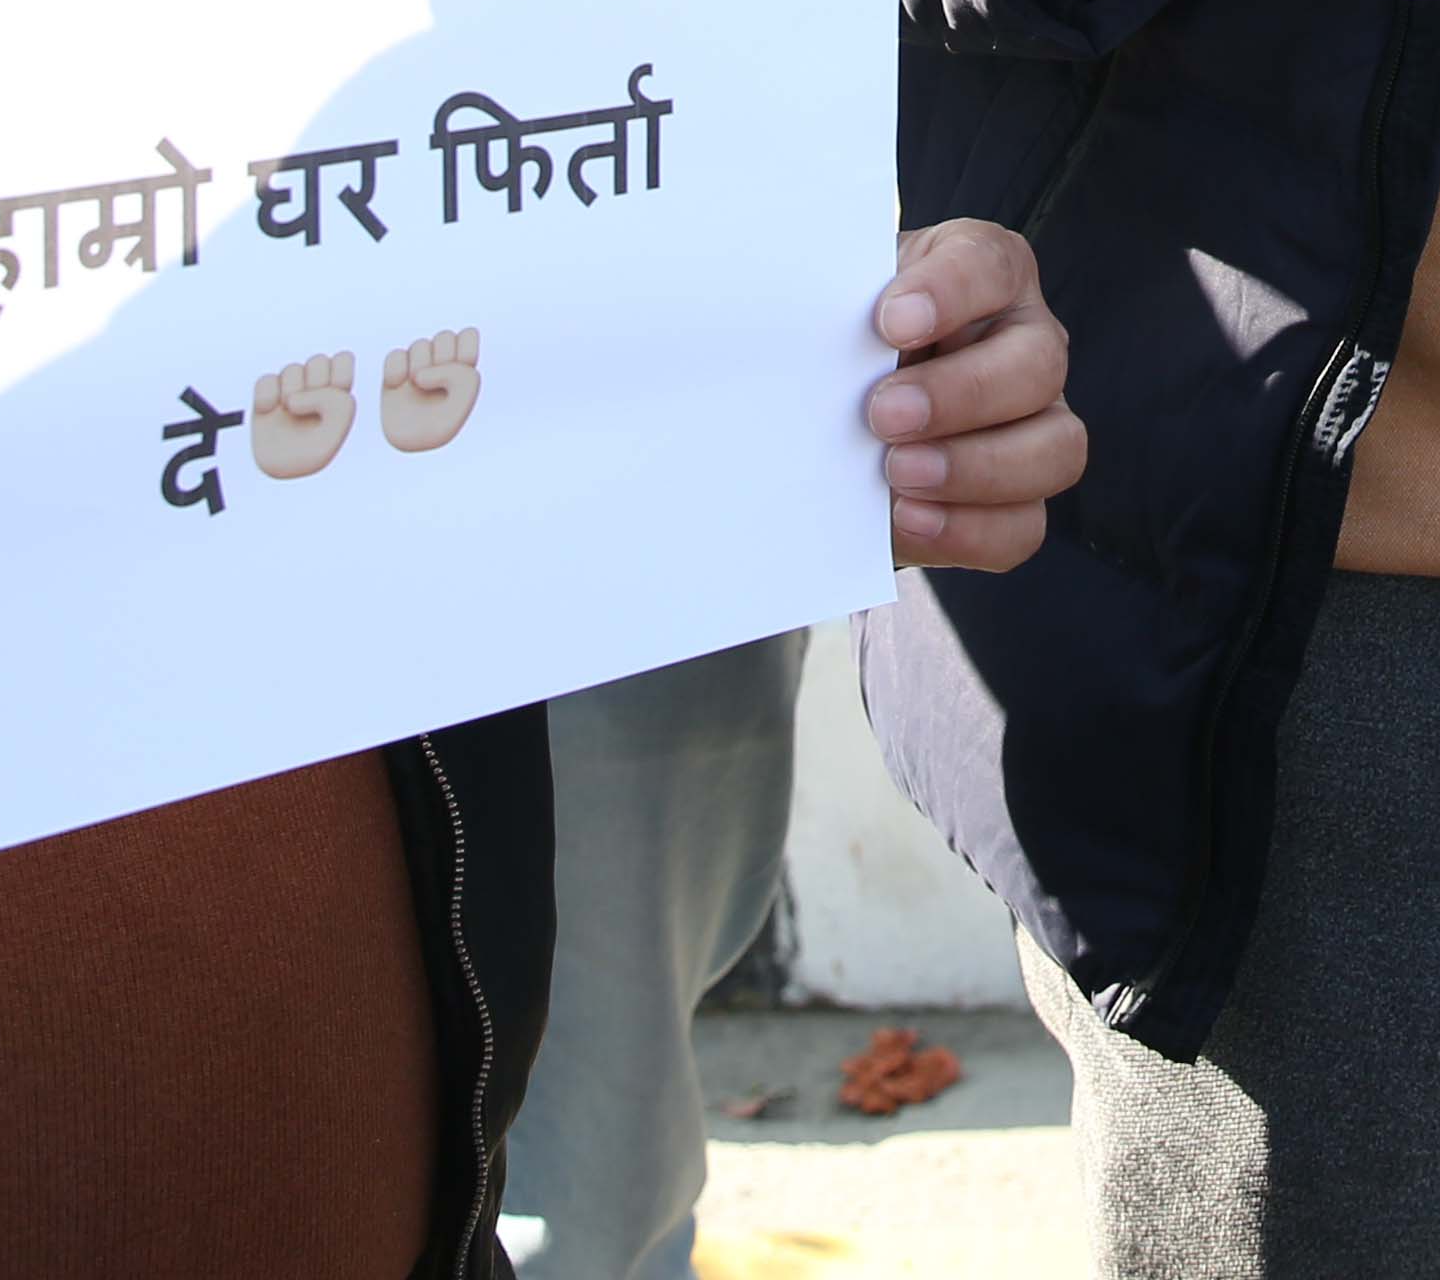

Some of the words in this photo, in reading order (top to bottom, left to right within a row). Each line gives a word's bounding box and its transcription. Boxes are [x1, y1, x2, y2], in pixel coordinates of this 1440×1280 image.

[247, 138, 400, 248] घर
[428, 62, 674, 225] फिर्ता
[159, 385, 246, 518] दे
